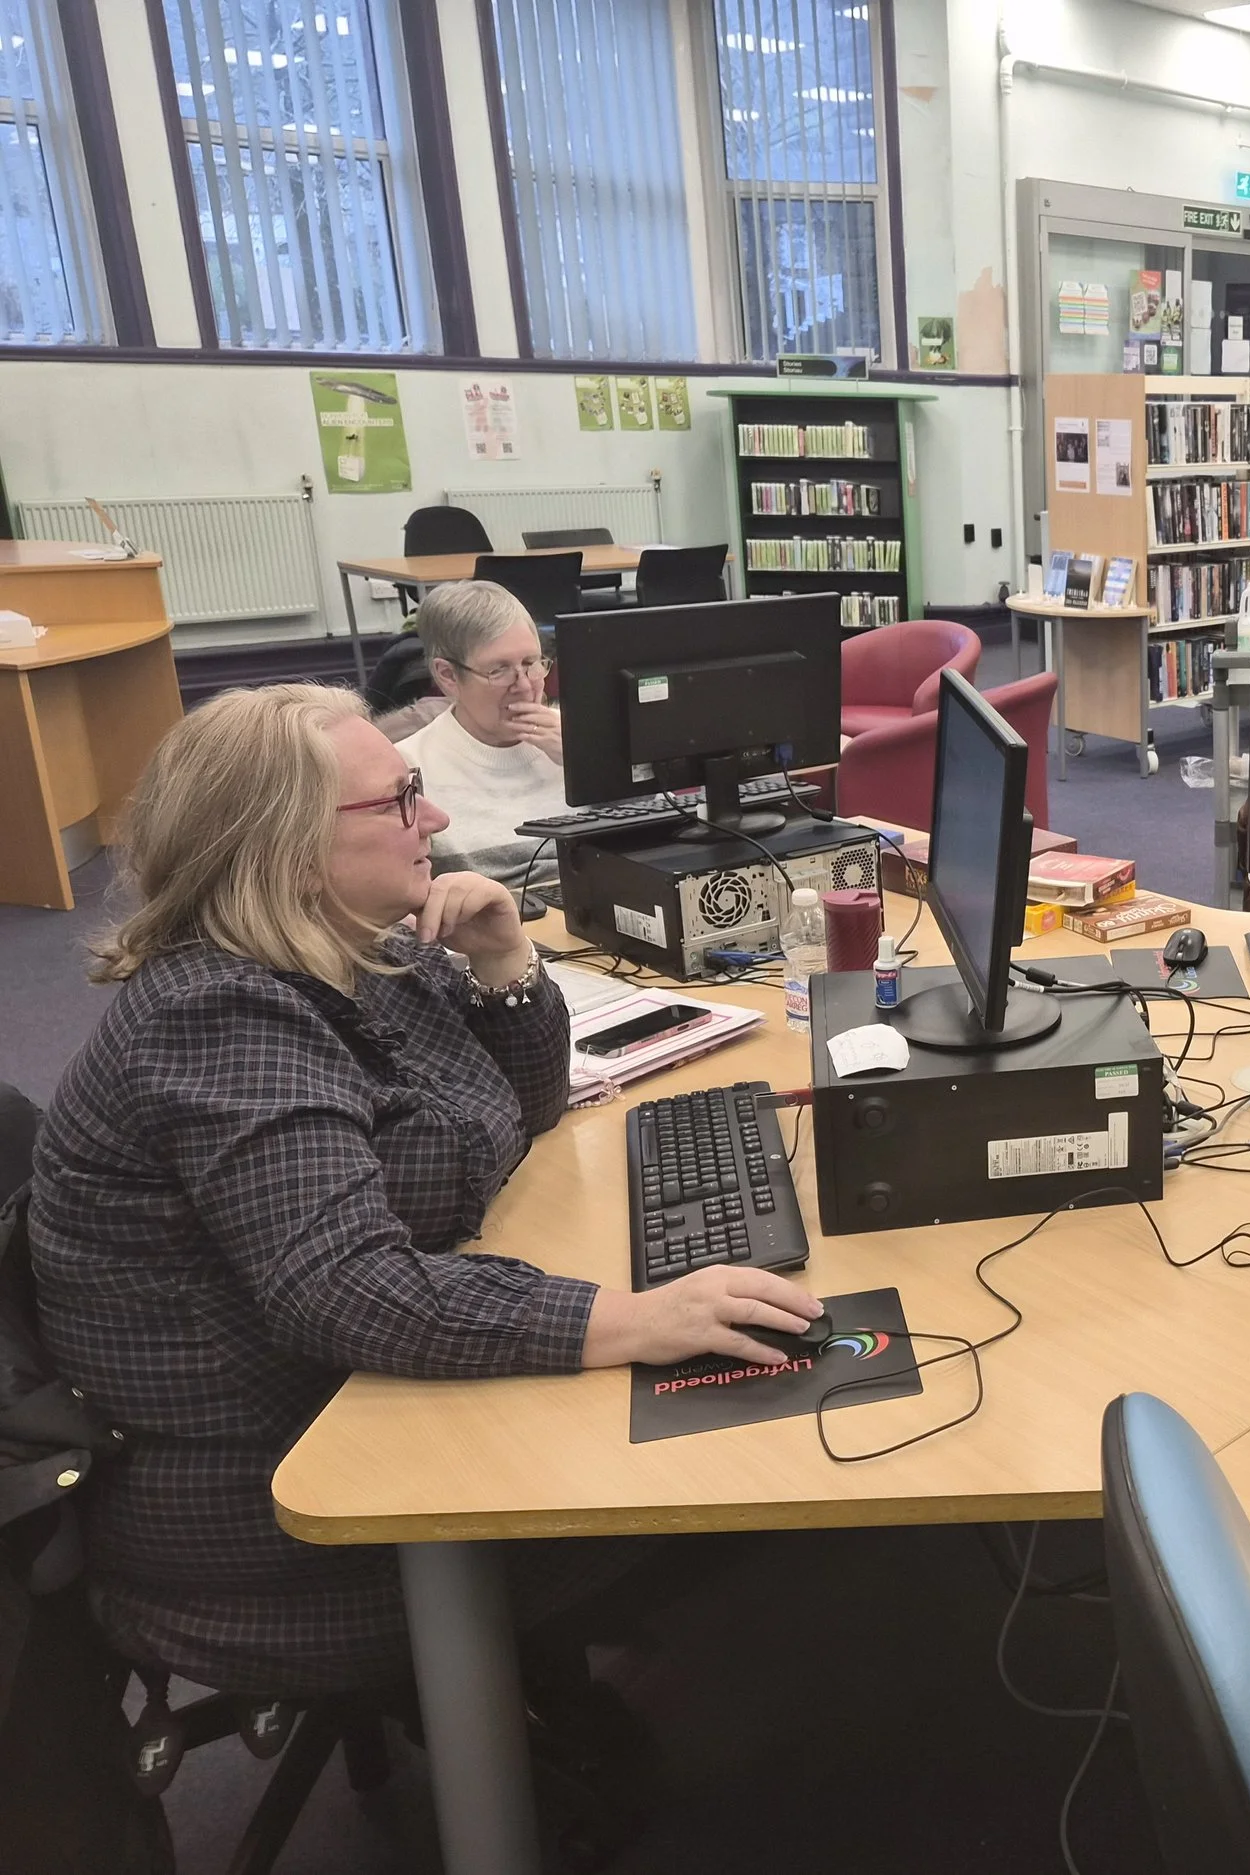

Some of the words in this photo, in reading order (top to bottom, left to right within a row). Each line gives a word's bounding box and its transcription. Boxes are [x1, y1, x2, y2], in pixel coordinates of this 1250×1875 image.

[1184, 211, 1198, 224] FIRE
[1199, 212, 1214, 226] EXIT
[654, 1357, 813, 1396] Llyfrgelloedd
